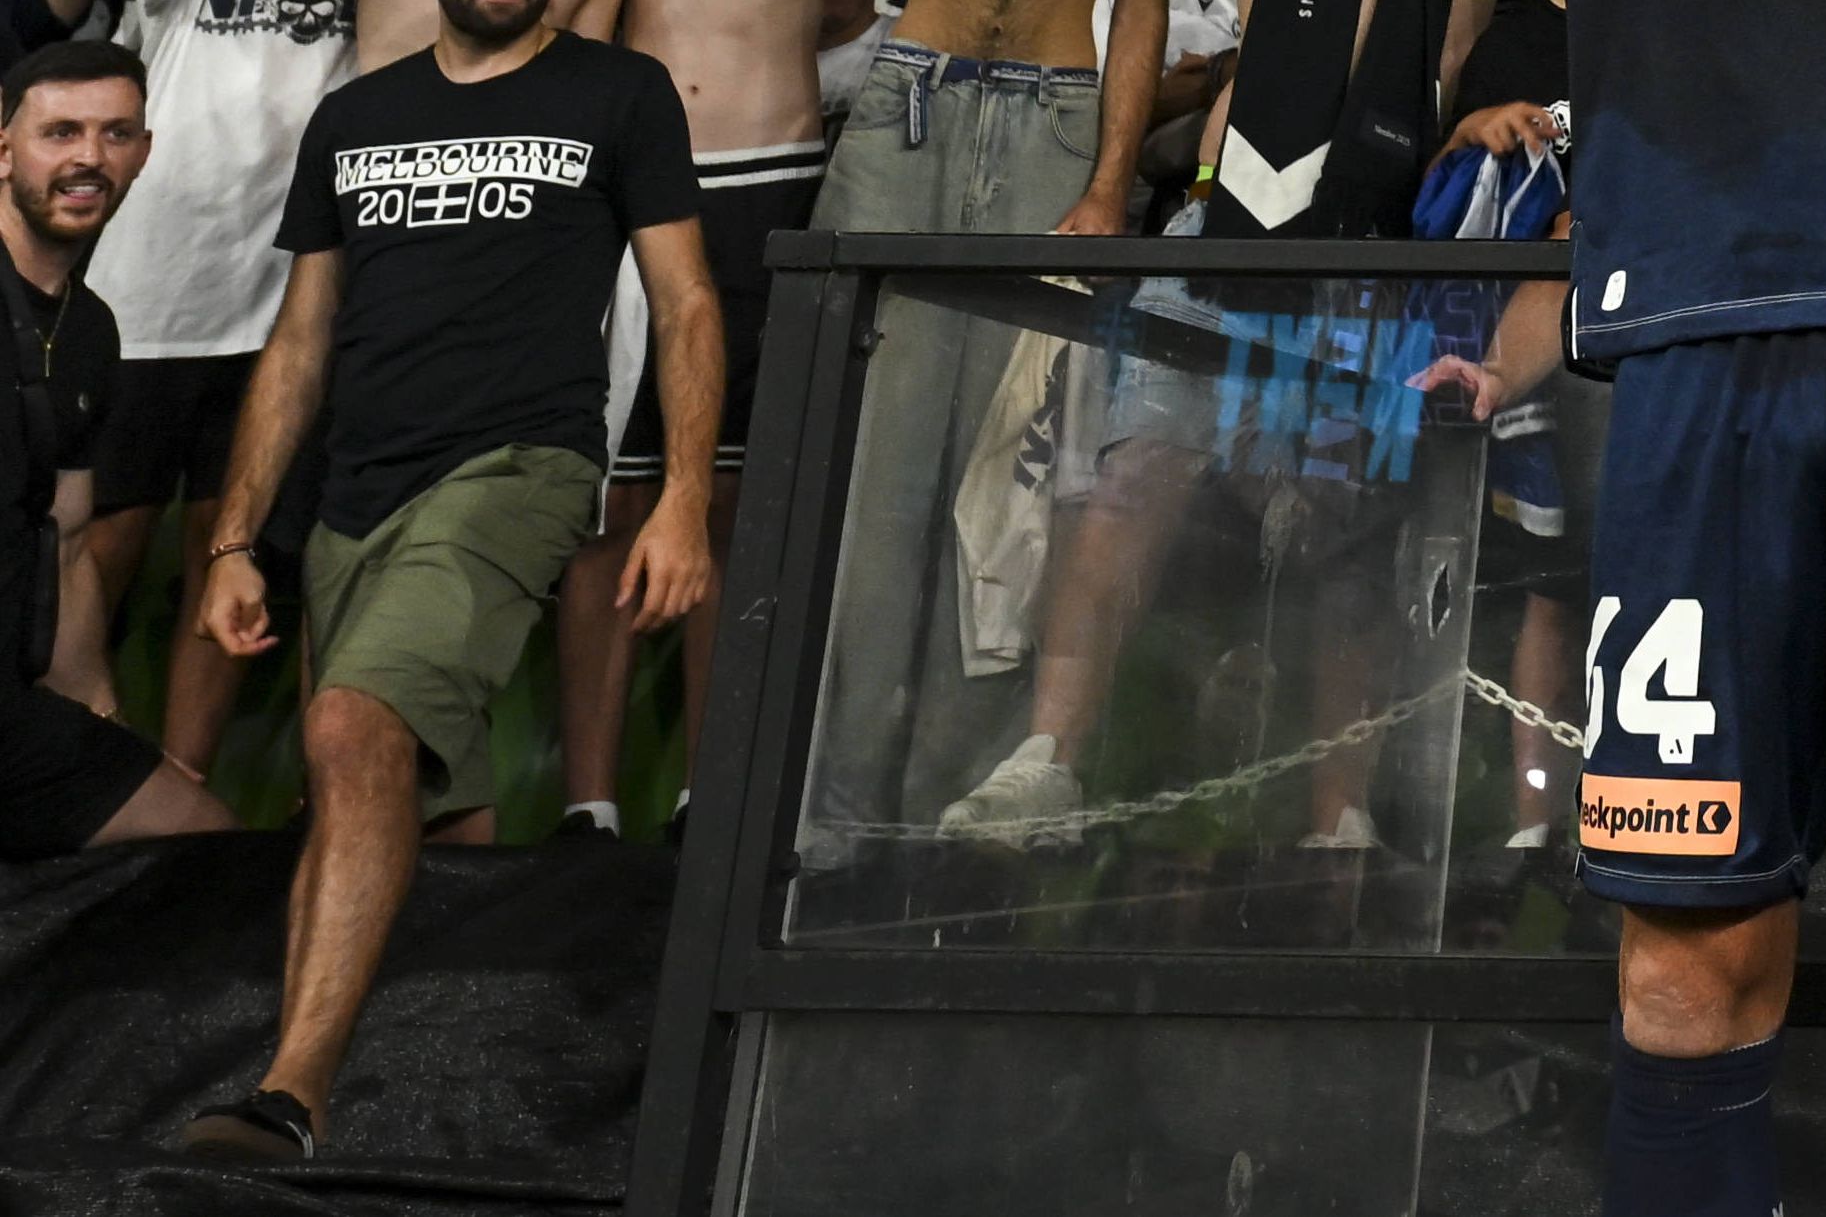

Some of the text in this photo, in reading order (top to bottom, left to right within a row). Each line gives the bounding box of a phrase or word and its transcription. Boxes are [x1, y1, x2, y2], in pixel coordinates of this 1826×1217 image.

[338, 141, 586, 188] MELBOURNE
[357, 182, 535, 227] 20 05
[1581, 795, 1691, 839] eckpoint
